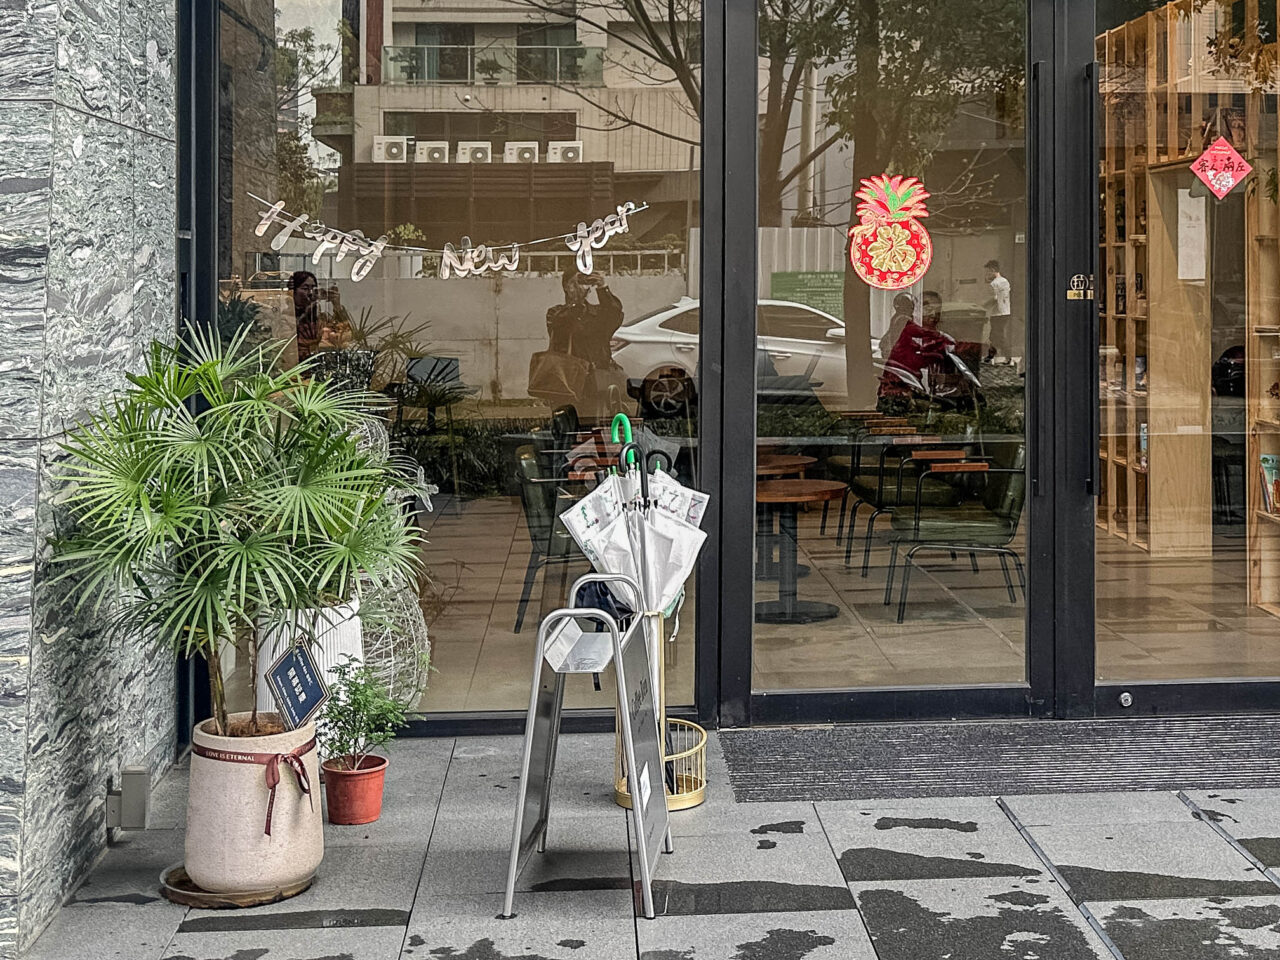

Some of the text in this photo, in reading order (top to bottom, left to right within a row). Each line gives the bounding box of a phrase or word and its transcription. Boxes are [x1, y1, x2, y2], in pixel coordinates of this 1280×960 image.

[255, 200, 389, 282] Happy
[440, 236, 519, 280] New
[226, 753, 255, 761] ETERNAL
